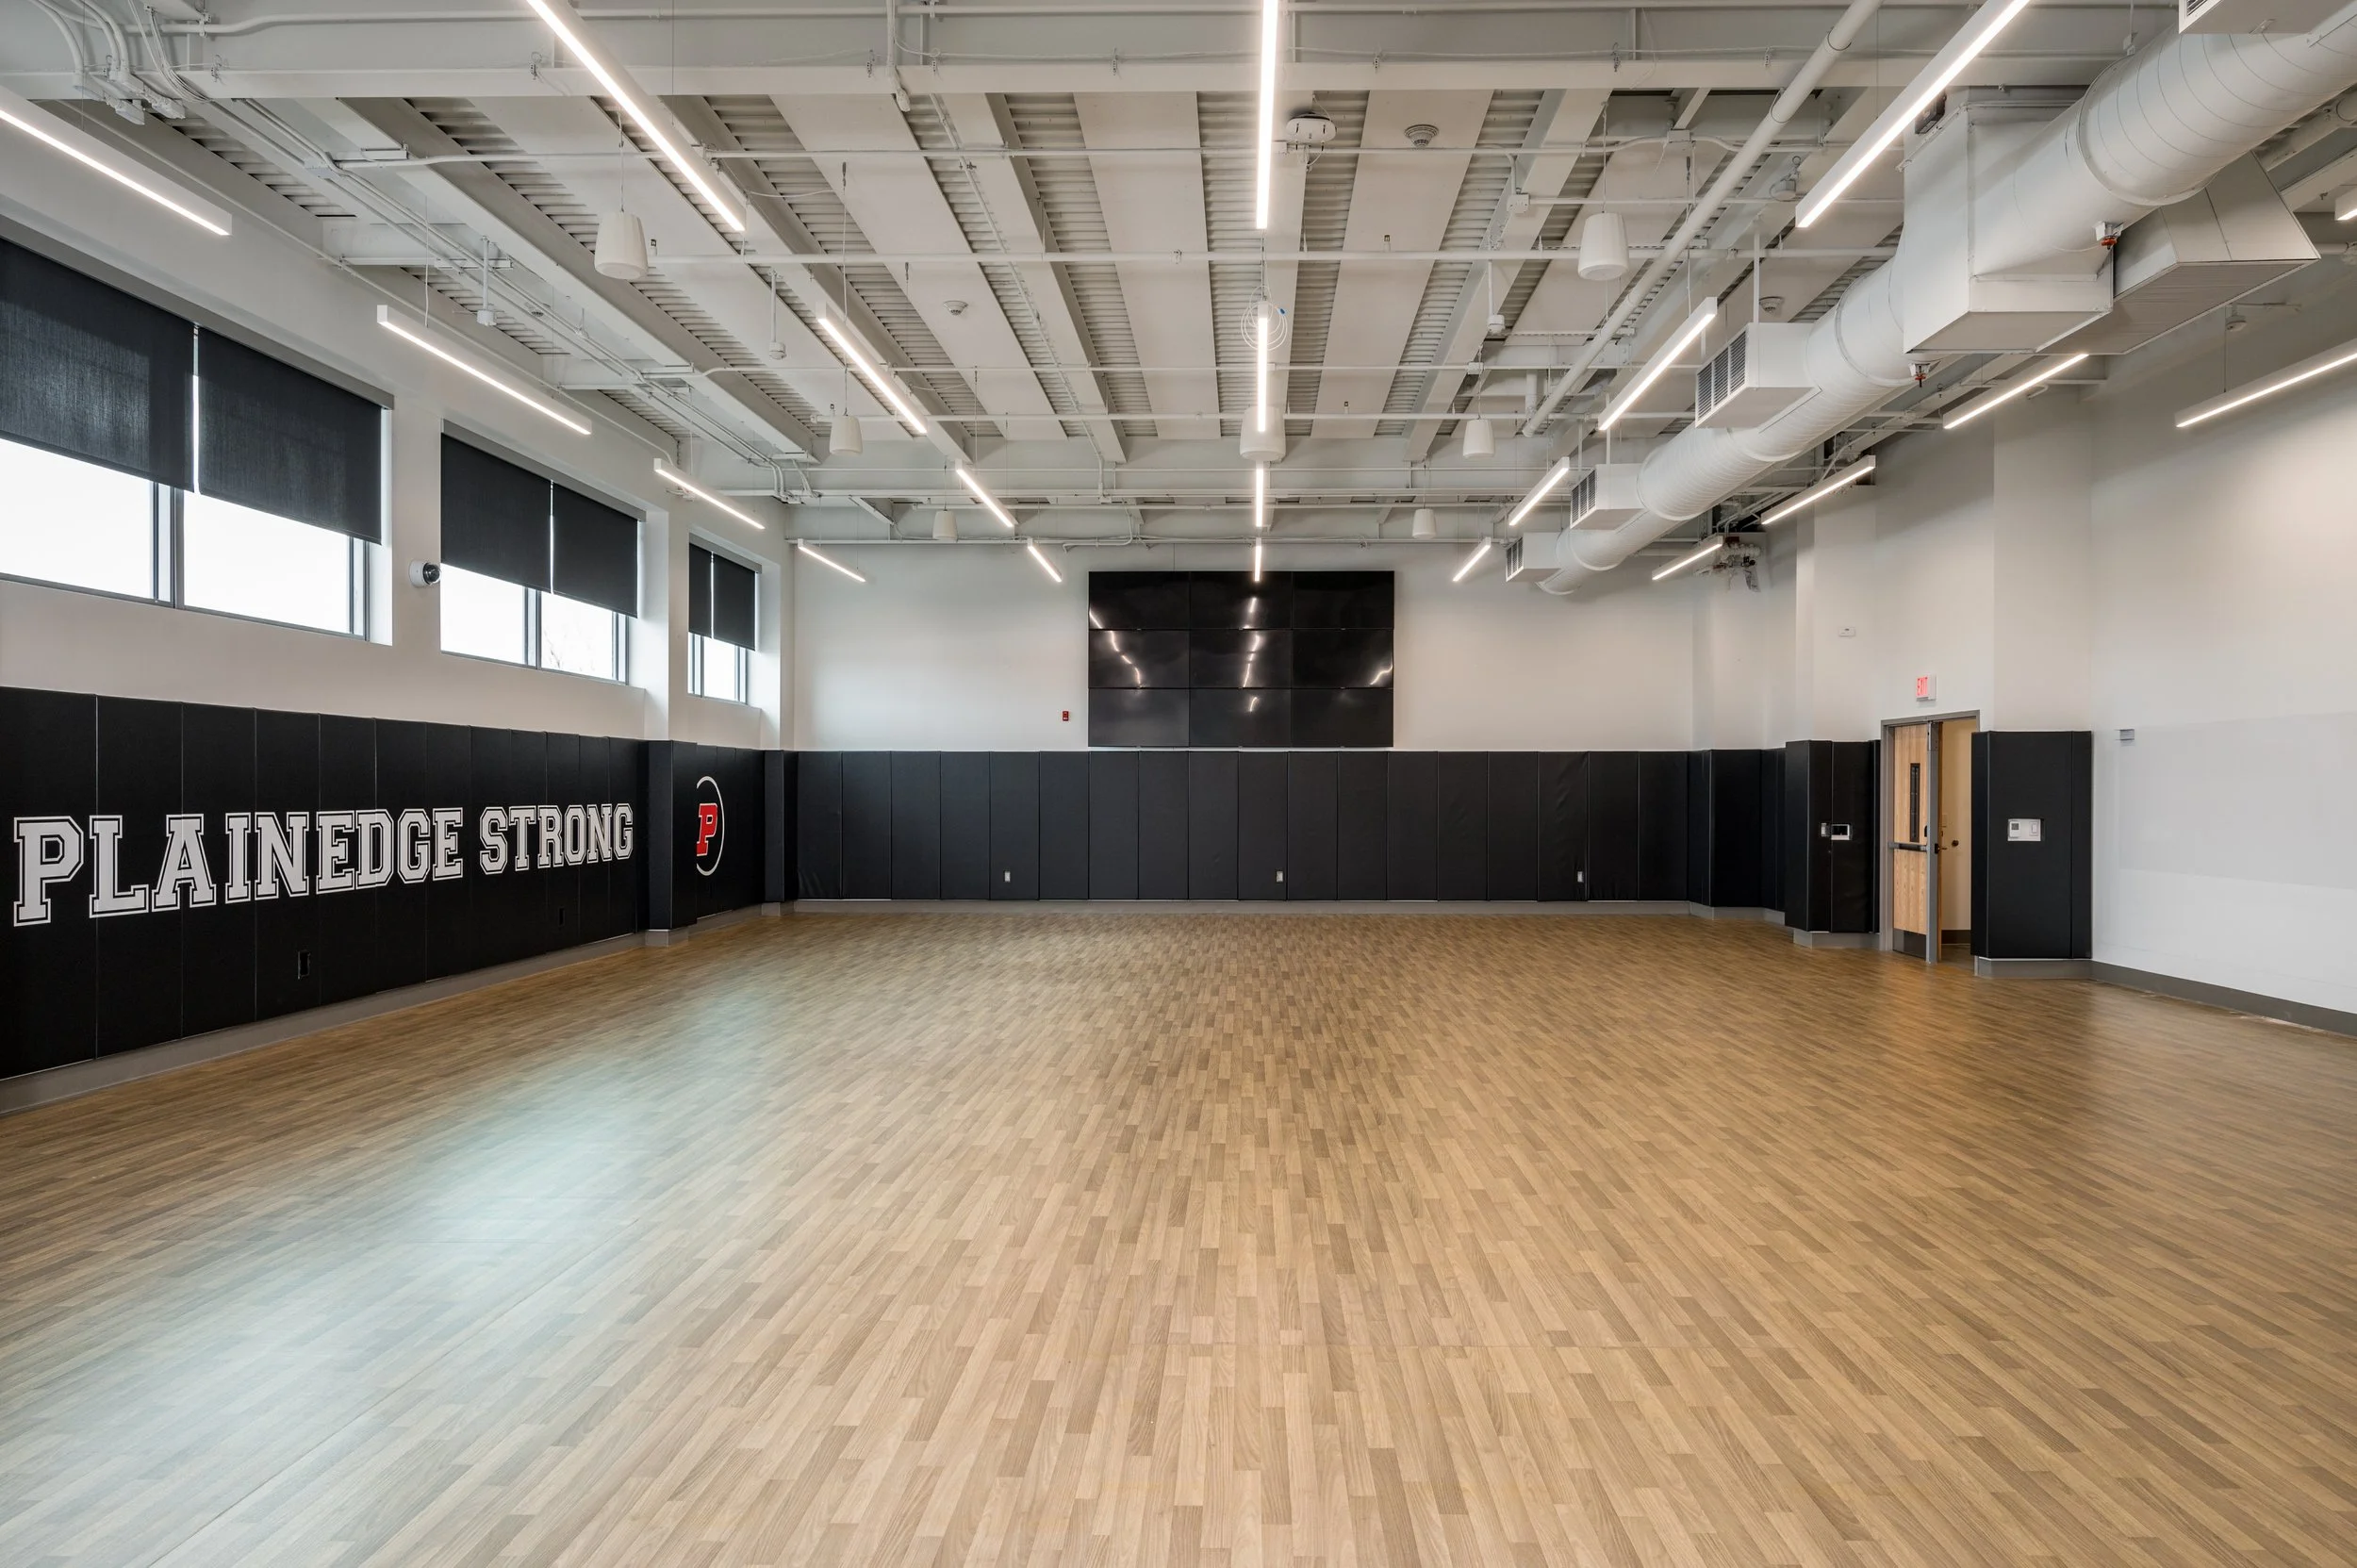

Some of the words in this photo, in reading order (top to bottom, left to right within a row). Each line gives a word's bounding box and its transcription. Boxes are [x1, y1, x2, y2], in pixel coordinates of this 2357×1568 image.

[1917, 677, 1928, 696] EXIT
[696, 802, 718, 857] P
[13, 806, 464, 927] PLAINEDGE
[479, 802, 634, 875] STRONG
